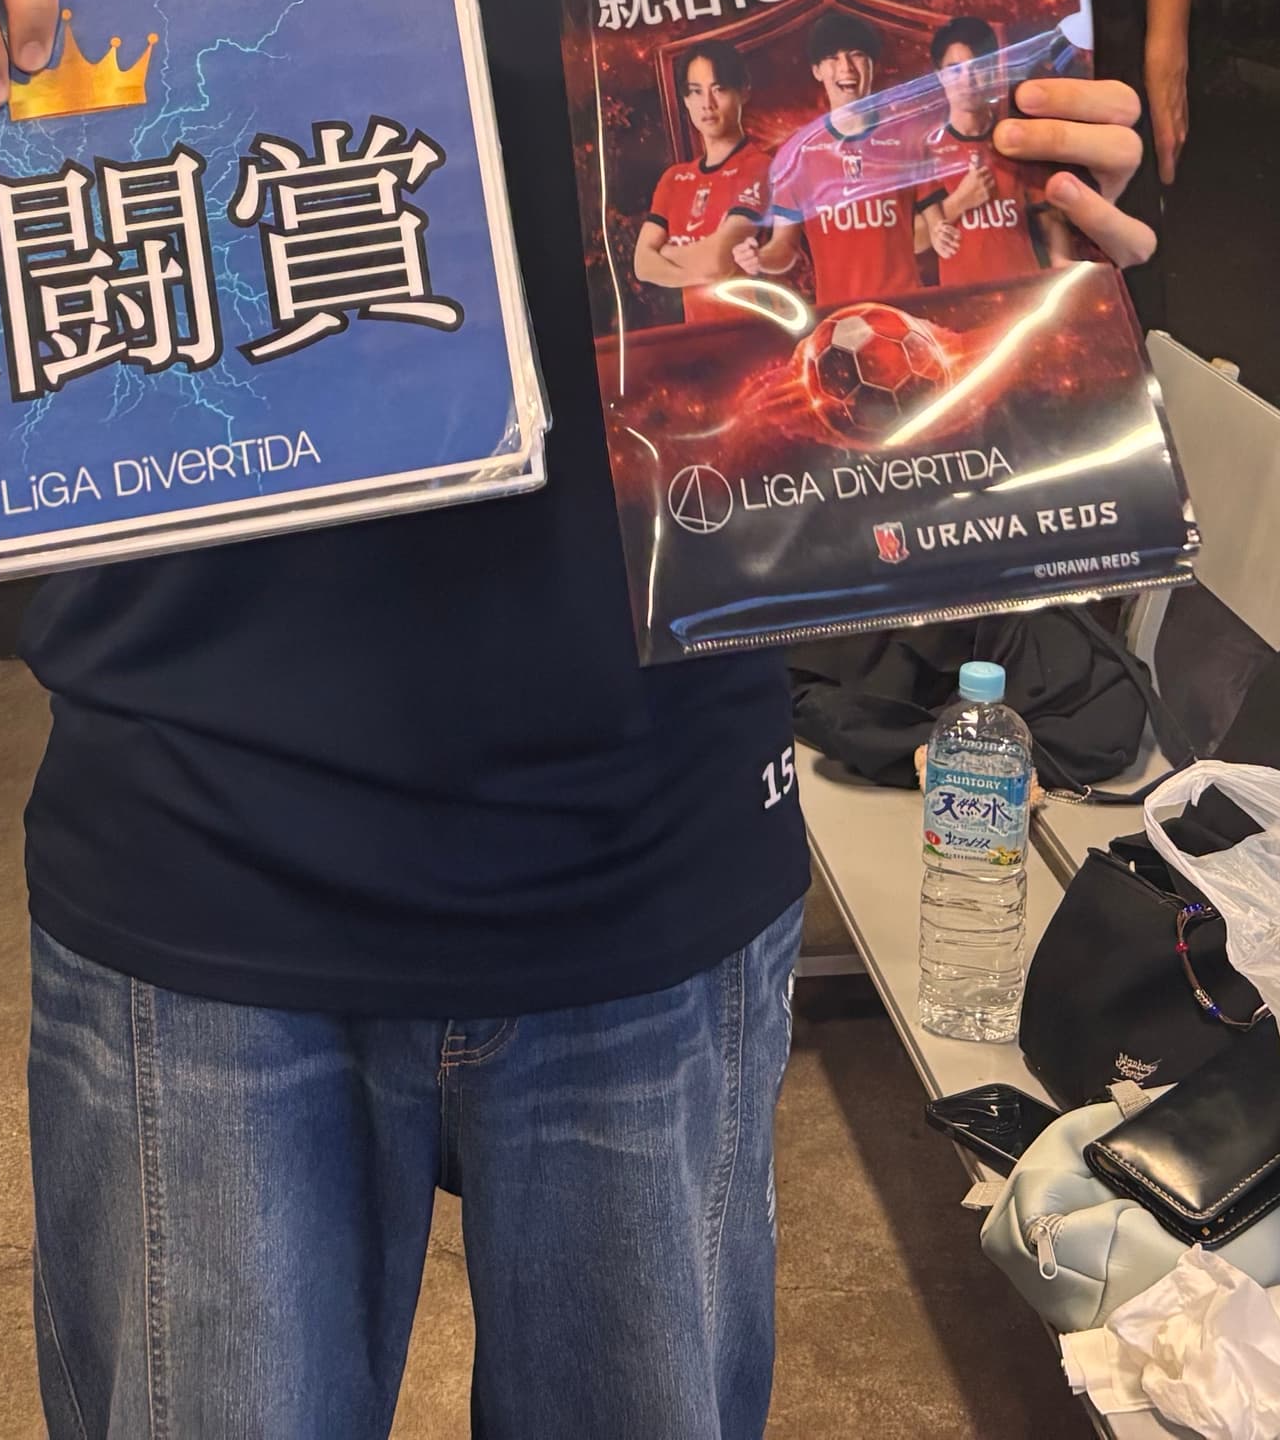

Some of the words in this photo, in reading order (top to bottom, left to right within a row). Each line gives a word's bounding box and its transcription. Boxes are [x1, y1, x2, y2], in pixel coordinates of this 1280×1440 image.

[816, 199, 897, 235] POLUS
[917, 513, 1027, 552] URAWA
[1038, 500, 1119, 536] REDS
[1100, 551, 1141, 574] REDS
[944, 773, 1001, 791] SUNTORY
[932, 791, 1014, 827] 天然水
